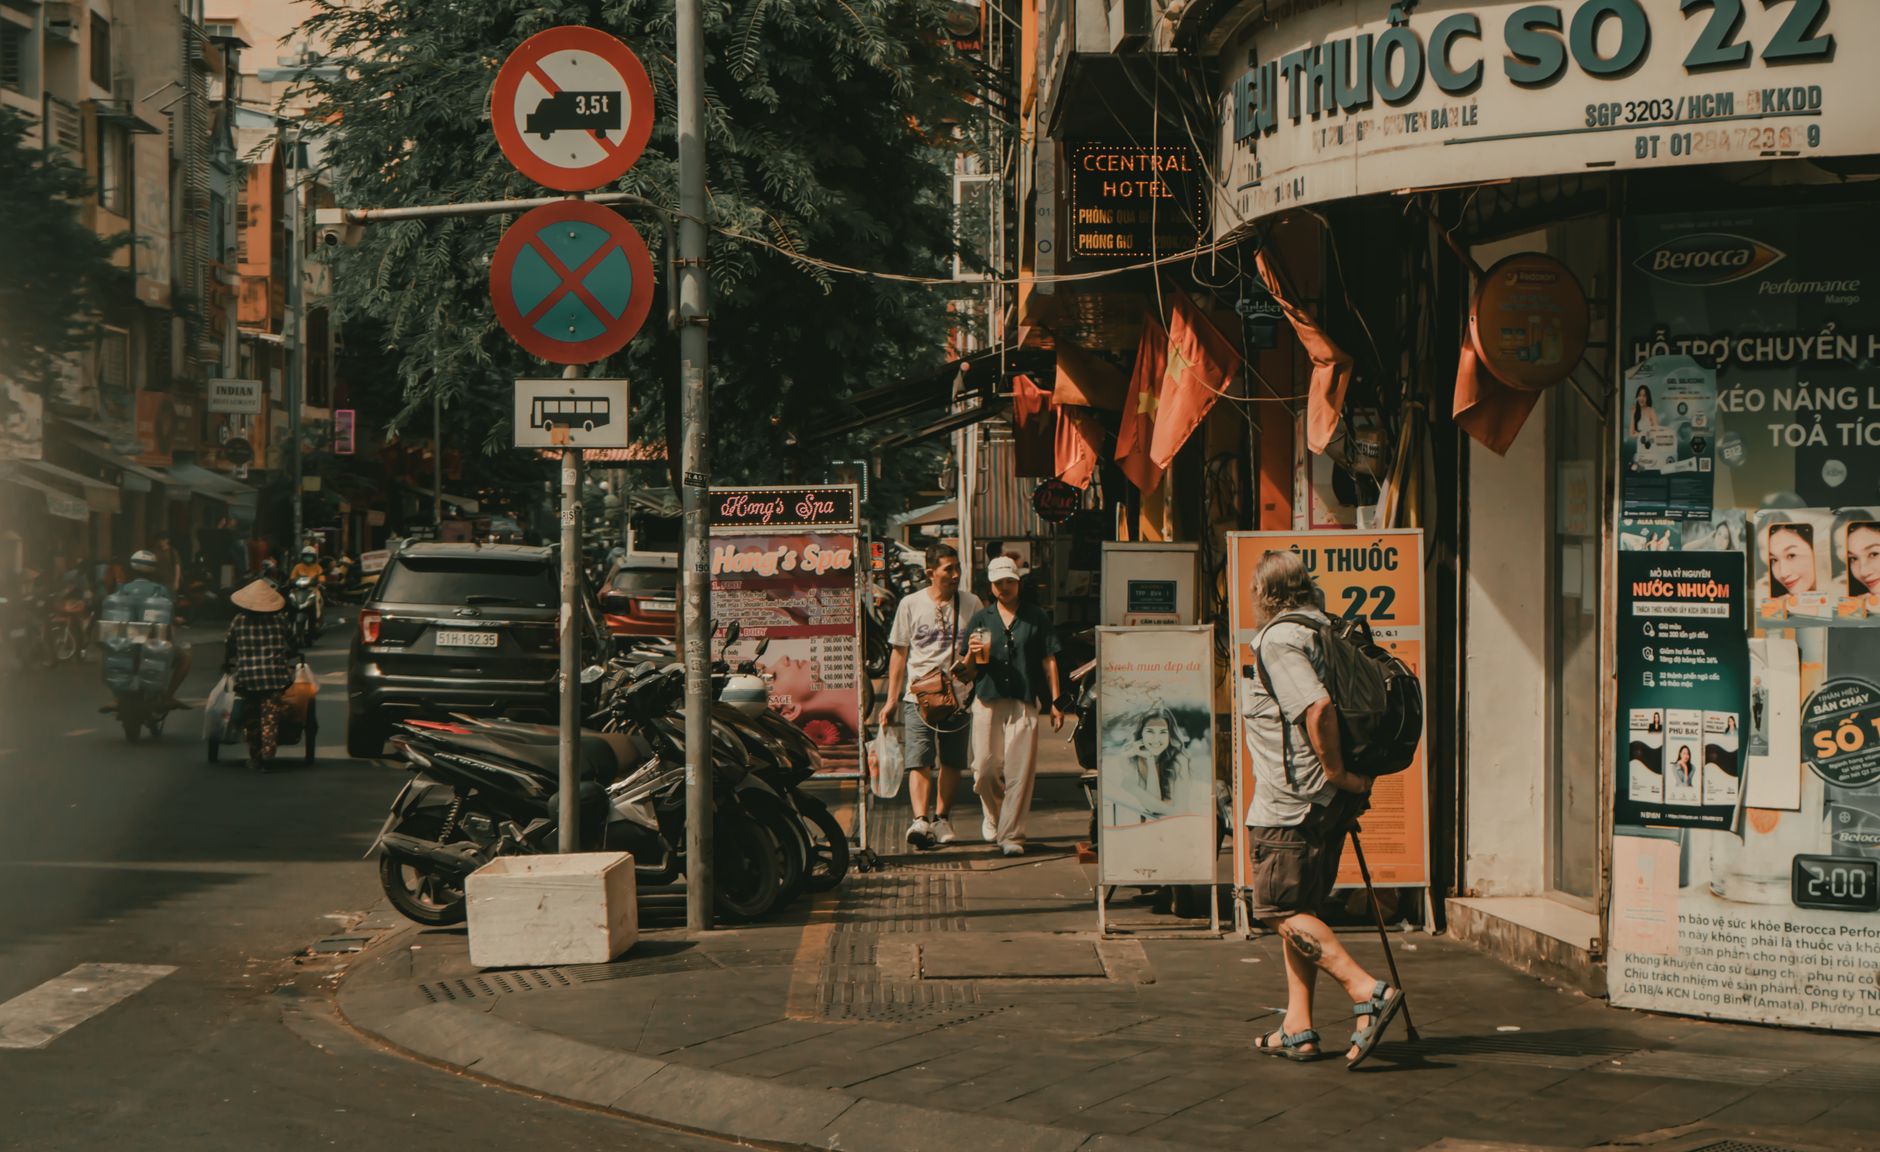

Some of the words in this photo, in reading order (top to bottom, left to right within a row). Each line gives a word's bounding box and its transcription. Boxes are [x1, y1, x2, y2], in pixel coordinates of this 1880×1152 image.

[1280, 2, 1484, 126] THUỐC
[1680, 0, 1836, 74] 22
[1103, 180, 1174, 198] HOTEL
[1079, 205, 1113, 224] PHÒNG
[1079, 231, 1113, 249] PHÒNG
[1652, 248, 1751, 272] Berocca
[1758, 278, 1861, 296] Performance
[1825, 294, 1861, 307] Mango
[1736, 322, 1858, 363] CHUYỂN
[216, 385, 254, 396] INDIAN
[1715, 382, 1766, 413] KÉO
[1772, 380, 1859, 412] NĂNG
[1767, 413, 1829, 447] TOẢ
[720, 494, 785, 523] Hong's
[795, 493, 835, 522] Spa
[711, 544, 798, 577] Hong's
[800, 542, 852, 576] Spa
[1323, 538, 1399, 573] THUỐC
[1632, 578, 1674, 597] NƯỚC
[1677, 578, 1730, 602] NHUỘM
[1341, 585, 1396, 621] 22
[743, 627, 768, 637] BODY
[1813, 701, 1839, 715] BÁN
[1839, 693, 1870, 710] CHẠY
[1813, 712, 1865, 759] SỐ
[1862, 760, 1877, 769] Nam
[1807, 865, 1868, 899] 2:00
[1712, 916, 1725, 931] vệ
[1784, 922, 1836, 936] Berocca
[1711, 931, 1747, 948] không
[1751, 935, 1778, 947] phải
[1781, 936, 1792, 949] là
[1795, 938, 1834, 951] thuốc
[1837, 940, 1852, 952] và
[1753, 951, 1776, 962] cho
[1779, 952, 1817, 966] người
[1820, 955, 1833, 969] bị
[1837, 971, 1855, 983] nữ
[1858, 973, 1874, 985] có
[1638, 984, 1664, 998] 118/4
[1666, 987, 1690, 999] KCN
[1692, 989, 1720, 1005] Long
[1811, 1000, 1865, 1017] Phường
[1804, 984, 1839, 1001] Công
[1842, 988, 1855, 1001] ty
